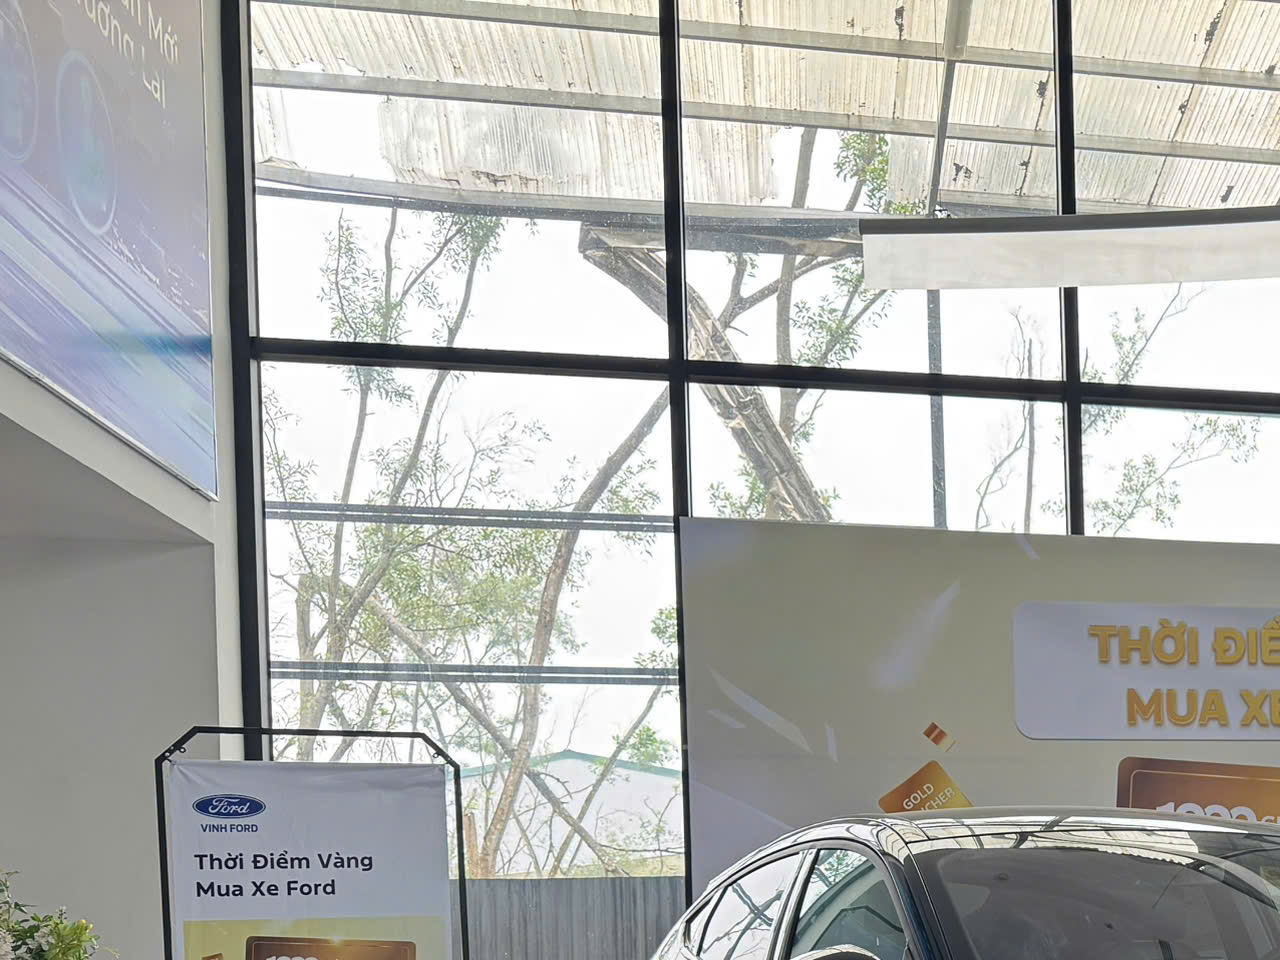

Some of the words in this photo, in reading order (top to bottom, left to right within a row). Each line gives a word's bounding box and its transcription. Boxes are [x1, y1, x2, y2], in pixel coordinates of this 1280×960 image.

[1088, 619, 1200, 666] THỜI
[1126, 688, 1230, 728] MUA
[903, 783, 934, 809] GOLD
[200, 823, 228, 833] VINH
[229, 823, 258, 833] FORD
[193, 852, 244, 870] Thời
[252, 850, 311, 870] Điểm
[317, 852, 373, 871] Vàng
[196, 881, 244, 897] Mua
[251, 880, 279, 896] Xe
[287, 879, 336, 896] Ford
